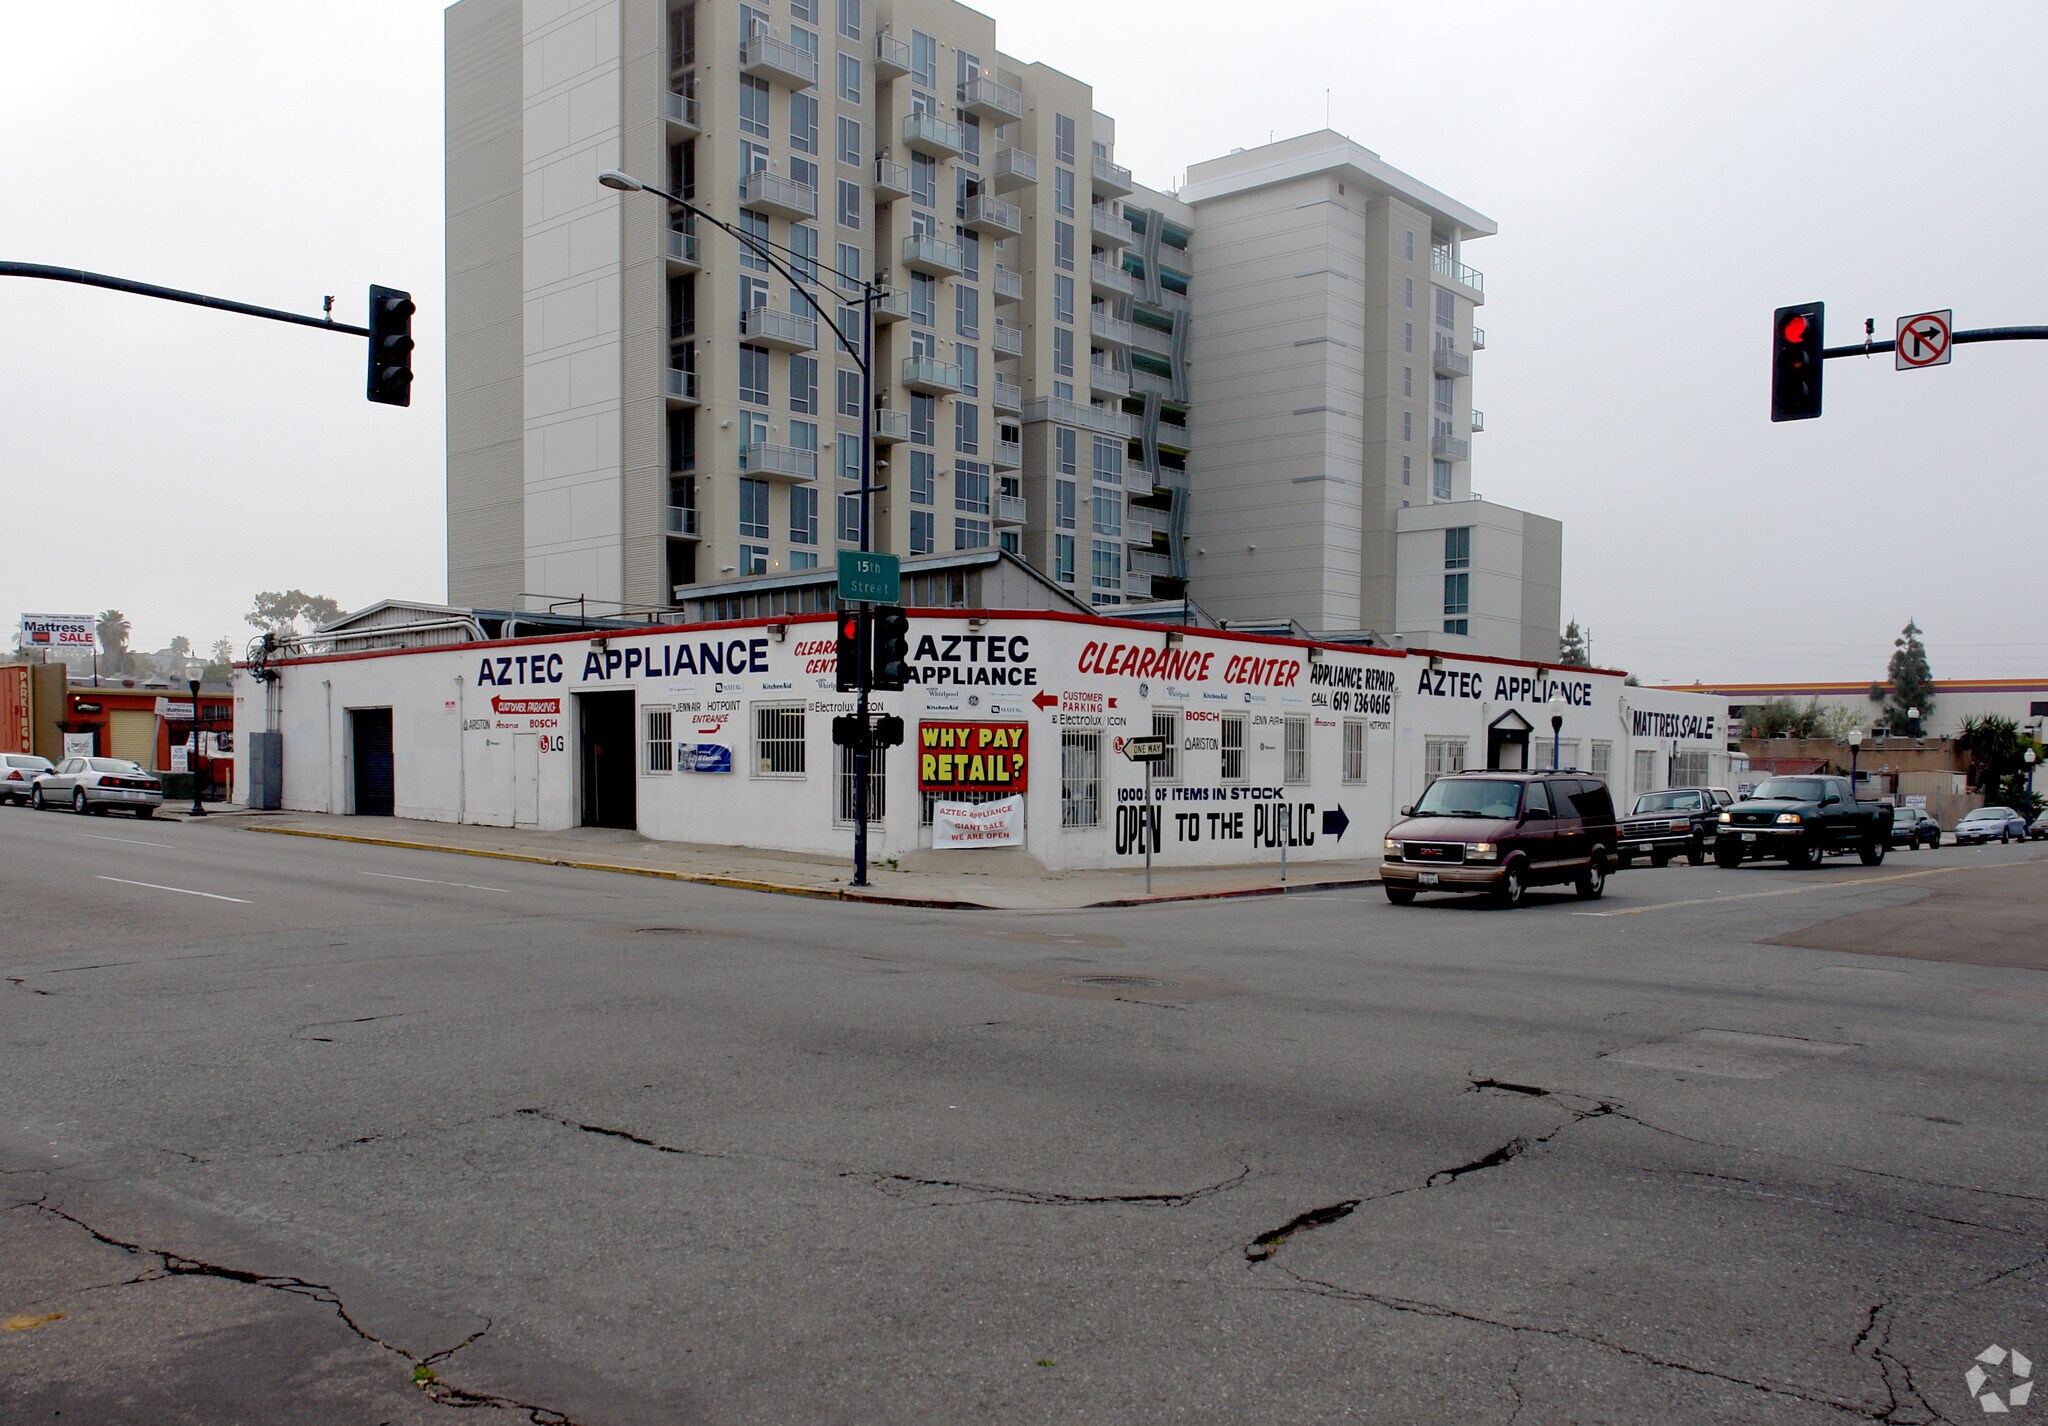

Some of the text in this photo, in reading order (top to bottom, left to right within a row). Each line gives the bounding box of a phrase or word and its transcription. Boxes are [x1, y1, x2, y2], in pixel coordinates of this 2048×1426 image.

[858, 561, 880, 573] 15th
[852, 581, 888, 594] Street
[24, 621, 85, 632] Mattress
[60, 632, 93, 642] SALE
[794, 640, 837, 656] CLEARA
[913, 634, 1029, 663] AZTEC
[478, 638, 769, 686] AZTEC APPLIANCE
[805, 658, 837, 674] CENT
[1078, 640, 1301, 687] CLEARANCE CENTER
[904, 665, 1037, 686] APPLIANCE
[1310, 663, 1395, 692] APPLIANCE REPAIR
[762, 682, 792, 690] KitchenAid
[817, 681, 836, 690] Whirlp
[1418, 668, 1591, 706] AZTEC APPLIANCE
[928, 690, 959, 699] Whirlpool
[1063, 691, 1103, 702] CUSTOMER
[1203, 692, 1228, 700] KitchenAid
[1311, 692, 1328, 704] CALL
[1330, 689, 1351, 711] (619)
[20, 671, 29, 737] PARKING
[499, 701, 556, 712] CUSTOMER PARKING
[707, 700, 741, 711] HOTPOINT
[815, 701, 855, 712] Electrolux
[1062, 702, 1103, 713] PARKING
[692, 713, 729, 724] ENTRANCE
[1185, 711, 1220, 722] BOSCH
[469, 719, 490, 730] ARISTON
[529, 719, 558, 728] BOSCH
[1633, 710, 1715, 739] MATTRESS SALE
[550, 735, 564, 751] LG
[922, 728, 1023, 748] WHY PAY
[1191, 738, 1219, 750] ARISTON
[1133, 744, 1161, 754] ONE WAY
[922, 754, 1024, 782] RETAIL?
[1155, 788, 1167, 801] OF
[1172, 787, 1209, 801] ITEMS
[1212, 787, 1227, 800] IN
[1230, 787, 1284, 799] STOCK
[939, 804, 1013, 819] AZTEC APPLIANCE
[954, 820, 1005, 831] GIANT SALE
[1115, 805, 1161, 855] OPEN
[1175, 812, 1200, 842] TO
[1206, 812, 1243, 840] THE
[967, 832, 984, 840] ARE
